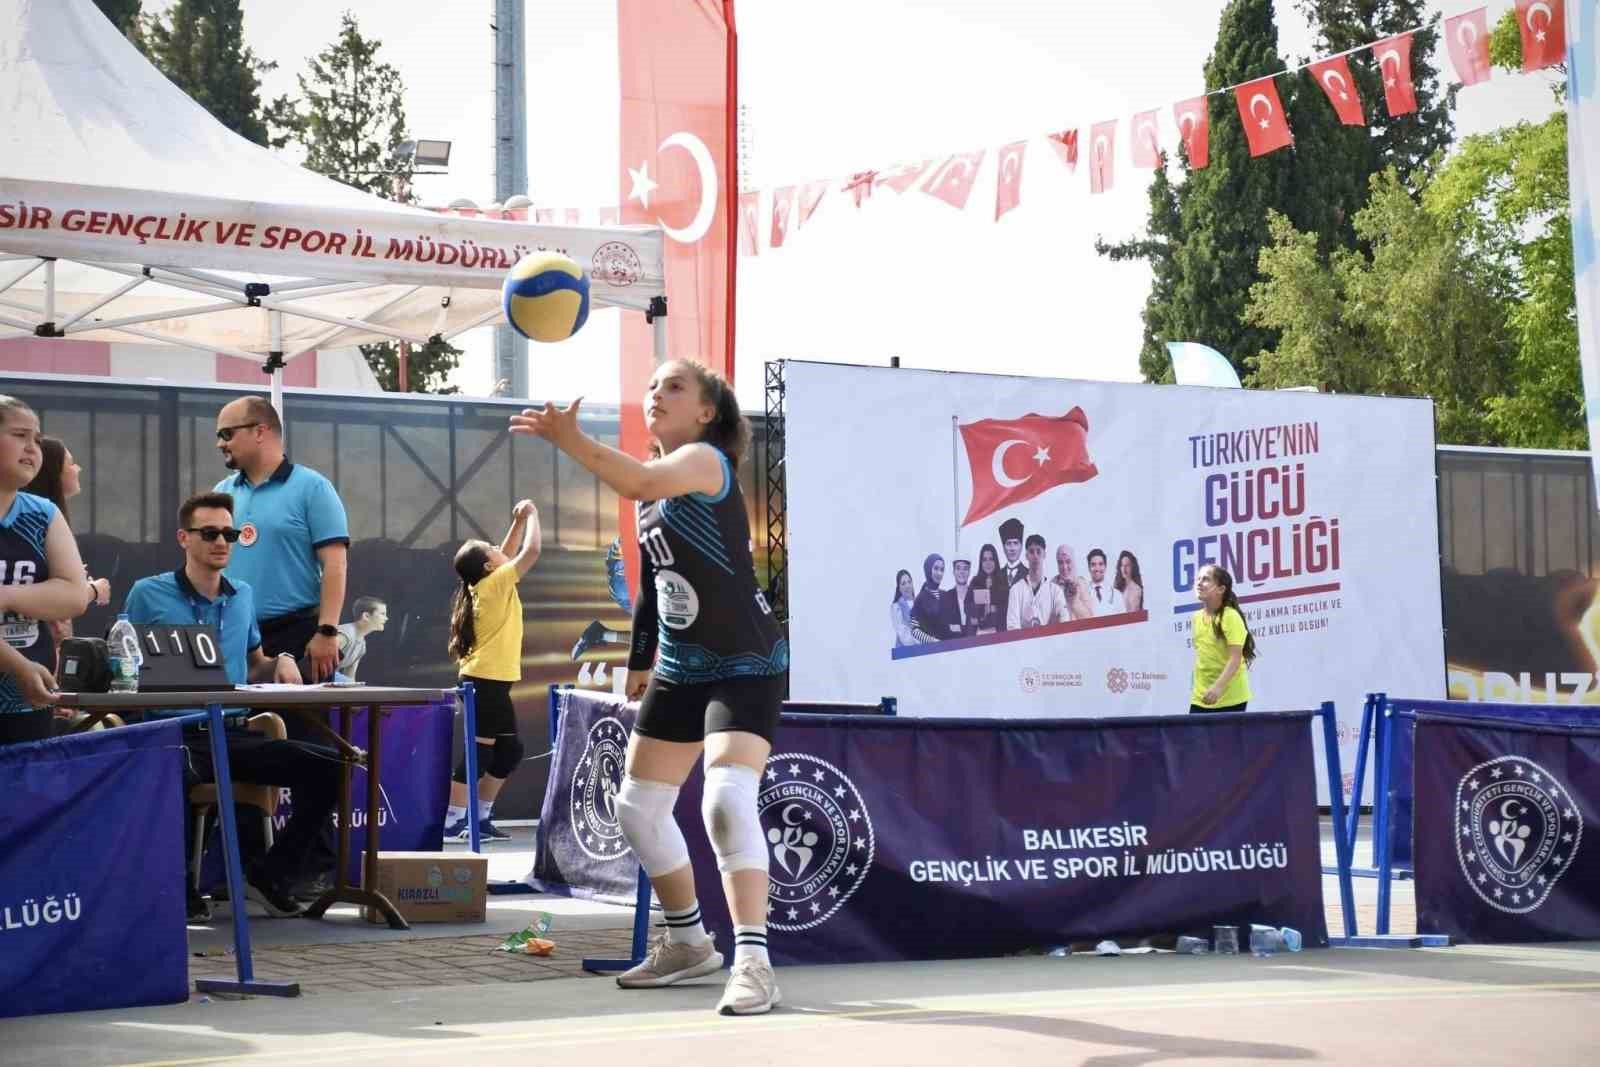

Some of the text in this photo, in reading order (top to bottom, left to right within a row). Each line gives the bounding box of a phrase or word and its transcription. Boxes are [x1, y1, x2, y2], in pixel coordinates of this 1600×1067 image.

[60, 209, 213, 245] GENÇLİK
[215, 221, 257, 247] VE
[259, 226, 348, 255] SPOR
[351, 229, 377, 258] İL
[1188, 421, 1320, 468] TÜRKİYE'NİN
[1205, 463, 1306, 527] GÜCÜ
[1173, 515, 1341, 593] GENÇLİĞİ
[1265, 605, 1290, 618] ANMA
[1331, 598, 1343, 609] VE
[1268, 622, 1296, 636] KUTLU
[782, 785, 824, 804] GENÇLİK
[823, 800, 836, 818] VE
[832, 814, 847, 844] SPOR
[1023, 821, 1149, 851] BALIKESİR
[909, 842, 1289, 886] GENÇLİK VE SPOR İL MÜDÜRLÜĞÜ
[0, 892, 81, 930] LÜĞÜ
